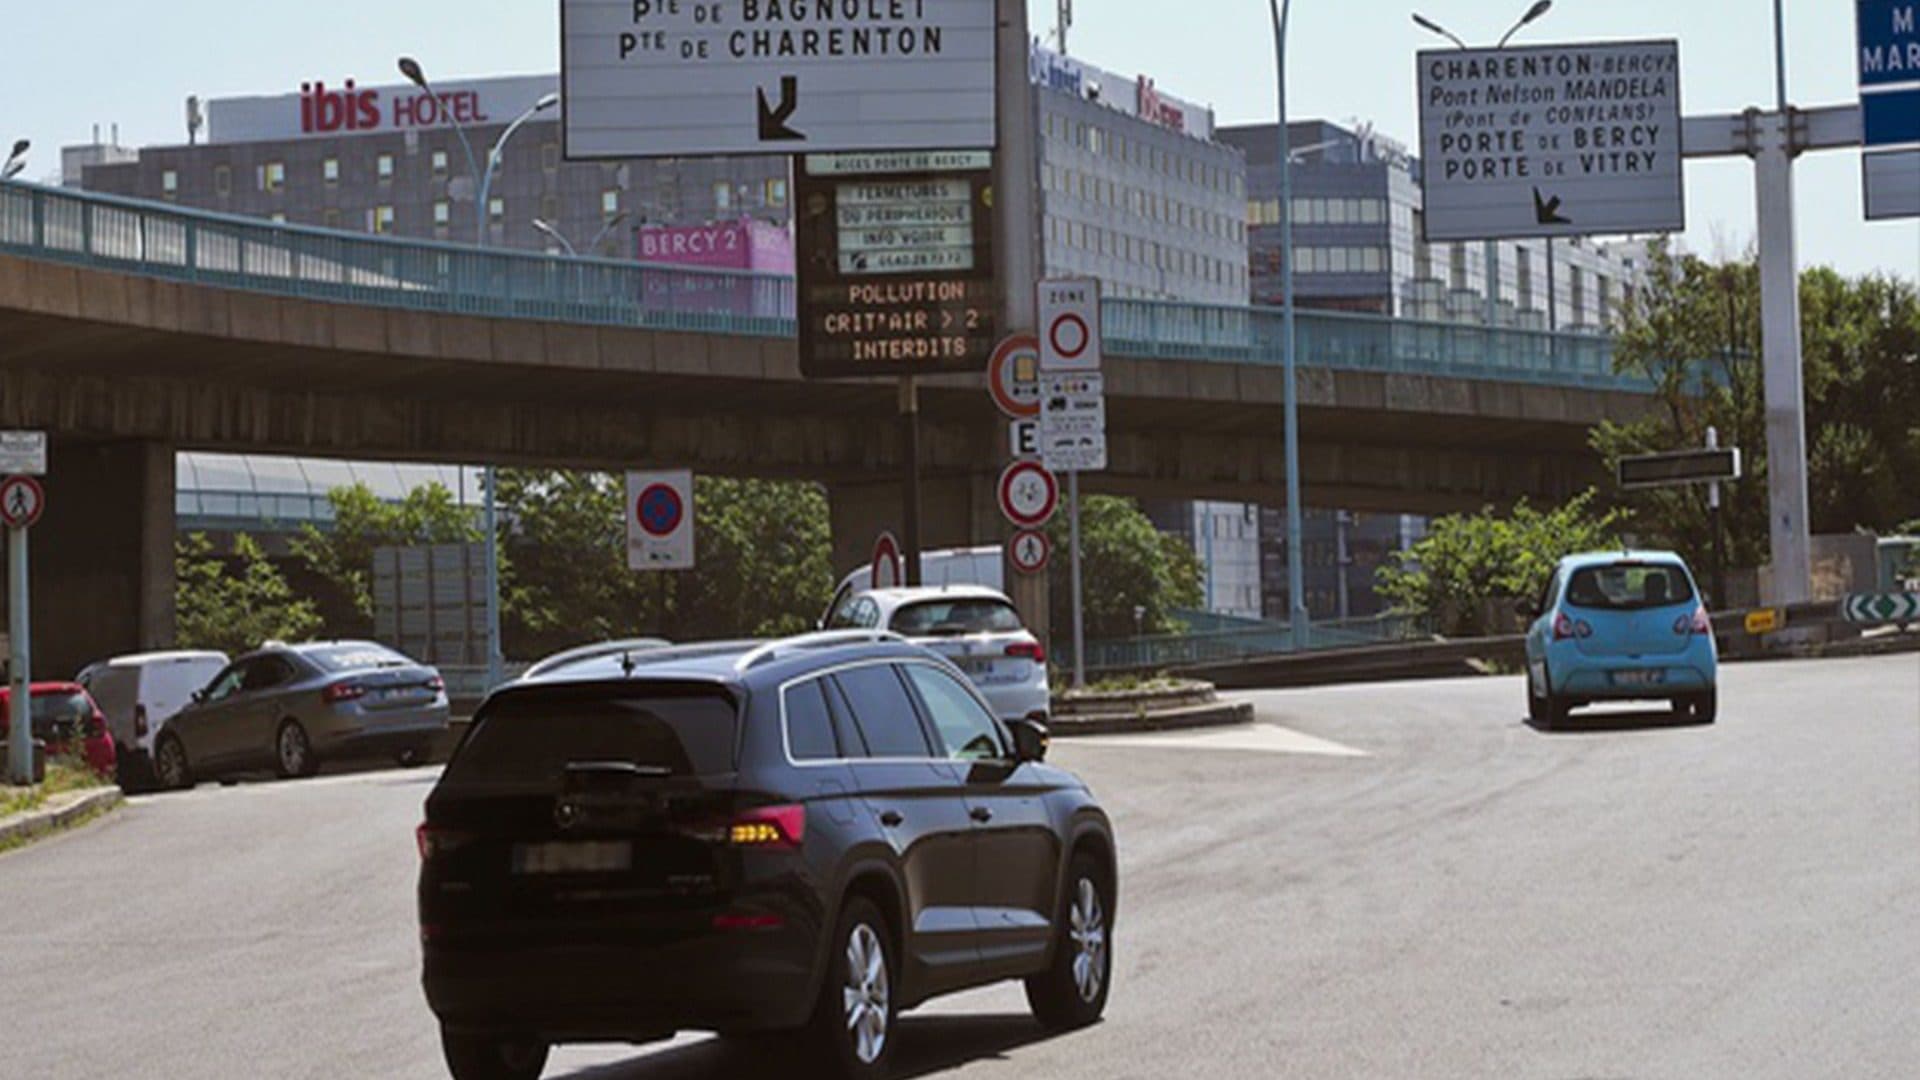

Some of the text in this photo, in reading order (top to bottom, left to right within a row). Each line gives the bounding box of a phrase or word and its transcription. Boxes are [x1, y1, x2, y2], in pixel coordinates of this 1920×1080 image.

[694, 4, 722, 23] DE
[619, 27, 941, 59] PTE DE CHARENTON
[301, 78, 487, 133] ibis HOTEL
[1430, 77, 1666, 107] Pont Nelson MANDELA
[1445, 102, 1656, 129] (Pont de CONFLANS)
[1440, 125, 1661, 153] PORTE DE BERCY
[1446, 151, 1657, 180] PORTE DE VITRY
[641, 230, 718, 257] BERCY
[723, 229, 737, 250] 2
[850, 281, 965, 304] POLLUTION
[1050, 290, 1085, 303] ZONE
[824, 310, 928, 334] CRIT'AIR
[965, 308, 979, 329] 2
[853, 336, 967, 361] INTERDITS
[1019, 423, 1036, 452] E
